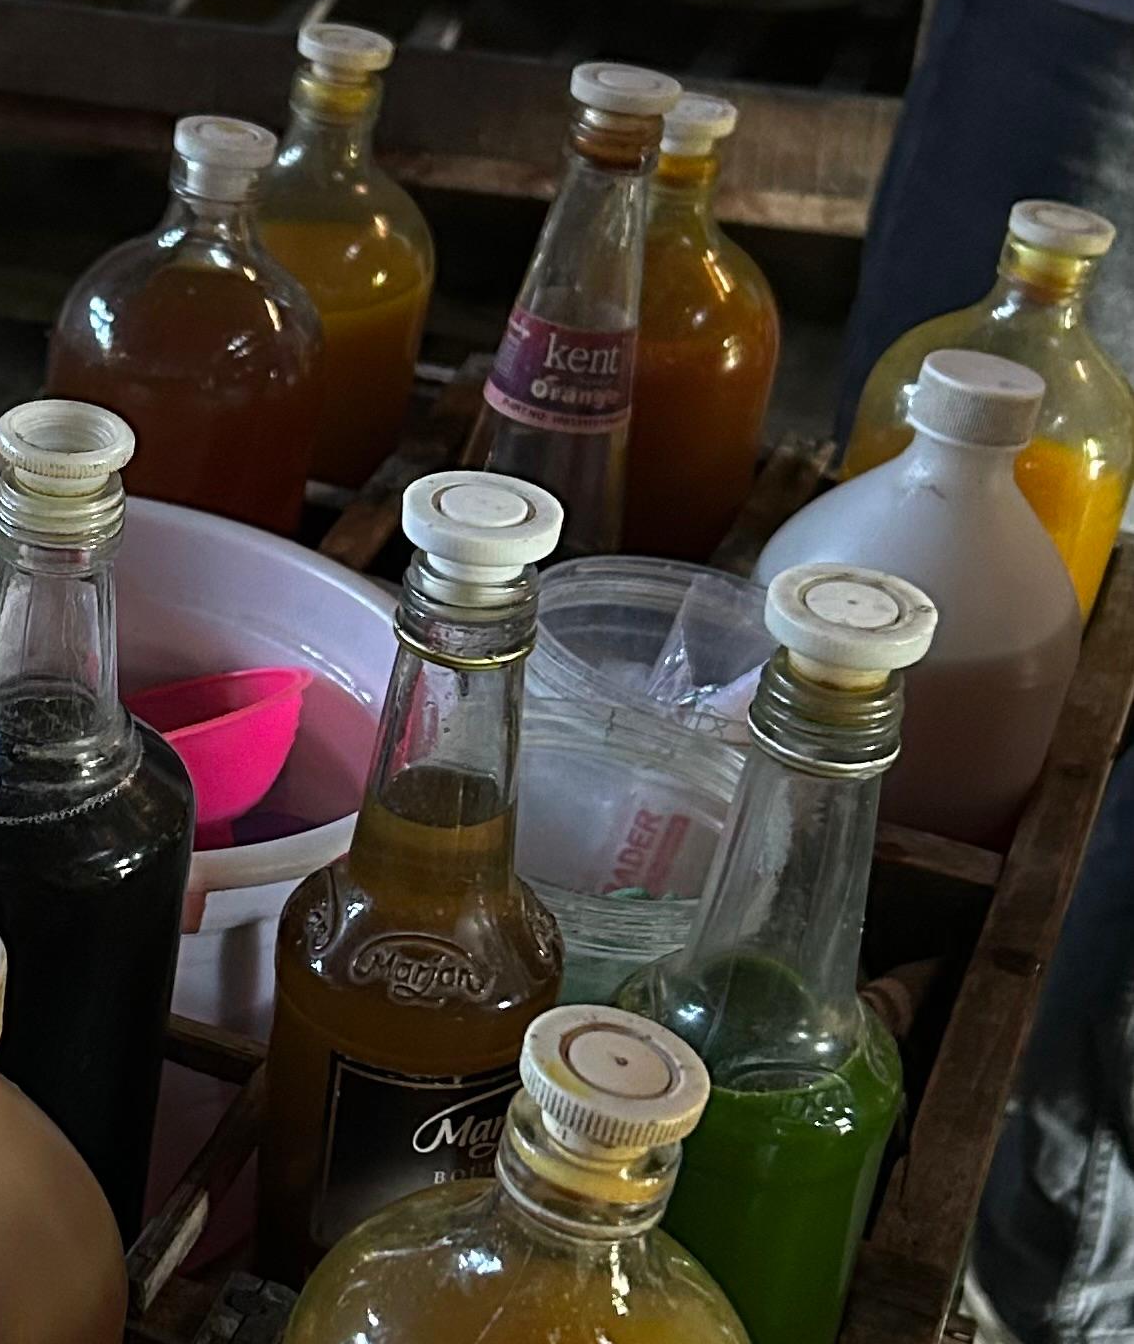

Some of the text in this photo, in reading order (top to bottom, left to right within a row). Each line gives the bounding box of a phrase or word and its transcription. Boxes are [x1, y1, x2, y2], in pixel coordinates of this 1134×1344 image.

[543, 332, 620, 375] kent
[602, 808, 664, 894] ADER
[351, 940, 491, 1006] Marjan
[412, 1094, 514, 1159] Mar
